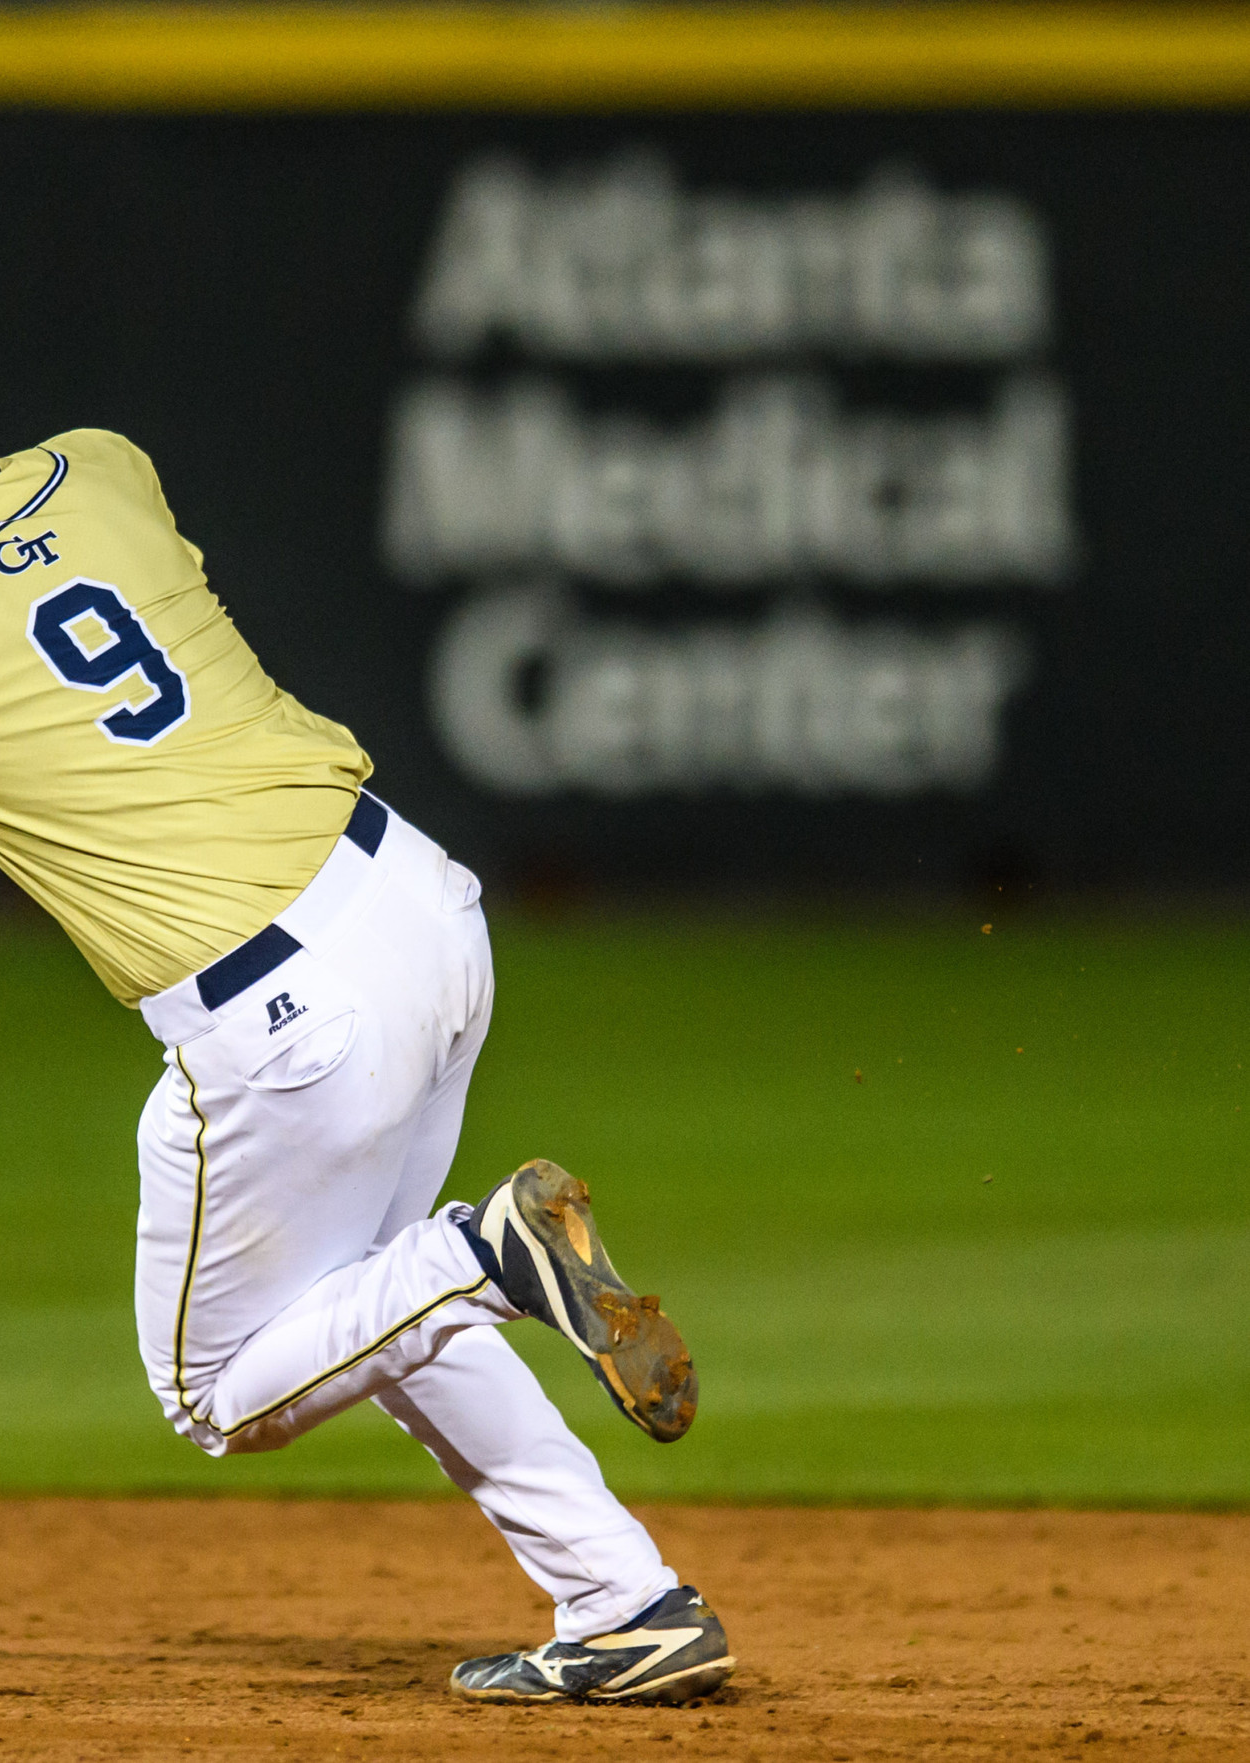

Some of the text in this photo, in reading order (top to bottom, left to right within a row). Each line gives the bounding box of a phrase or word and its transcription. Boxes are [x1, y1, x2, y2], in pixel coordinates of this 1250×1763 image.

[412, 150, 1052, 355] Atlanta
[385, 375, 1075, 582] Medical
[24, 575, 191, 748] 9
[432, 592, 1030, 795] Center
[265, 991, 296, 1025] R
[268, 1004, 310, 1036] RUSSELL
